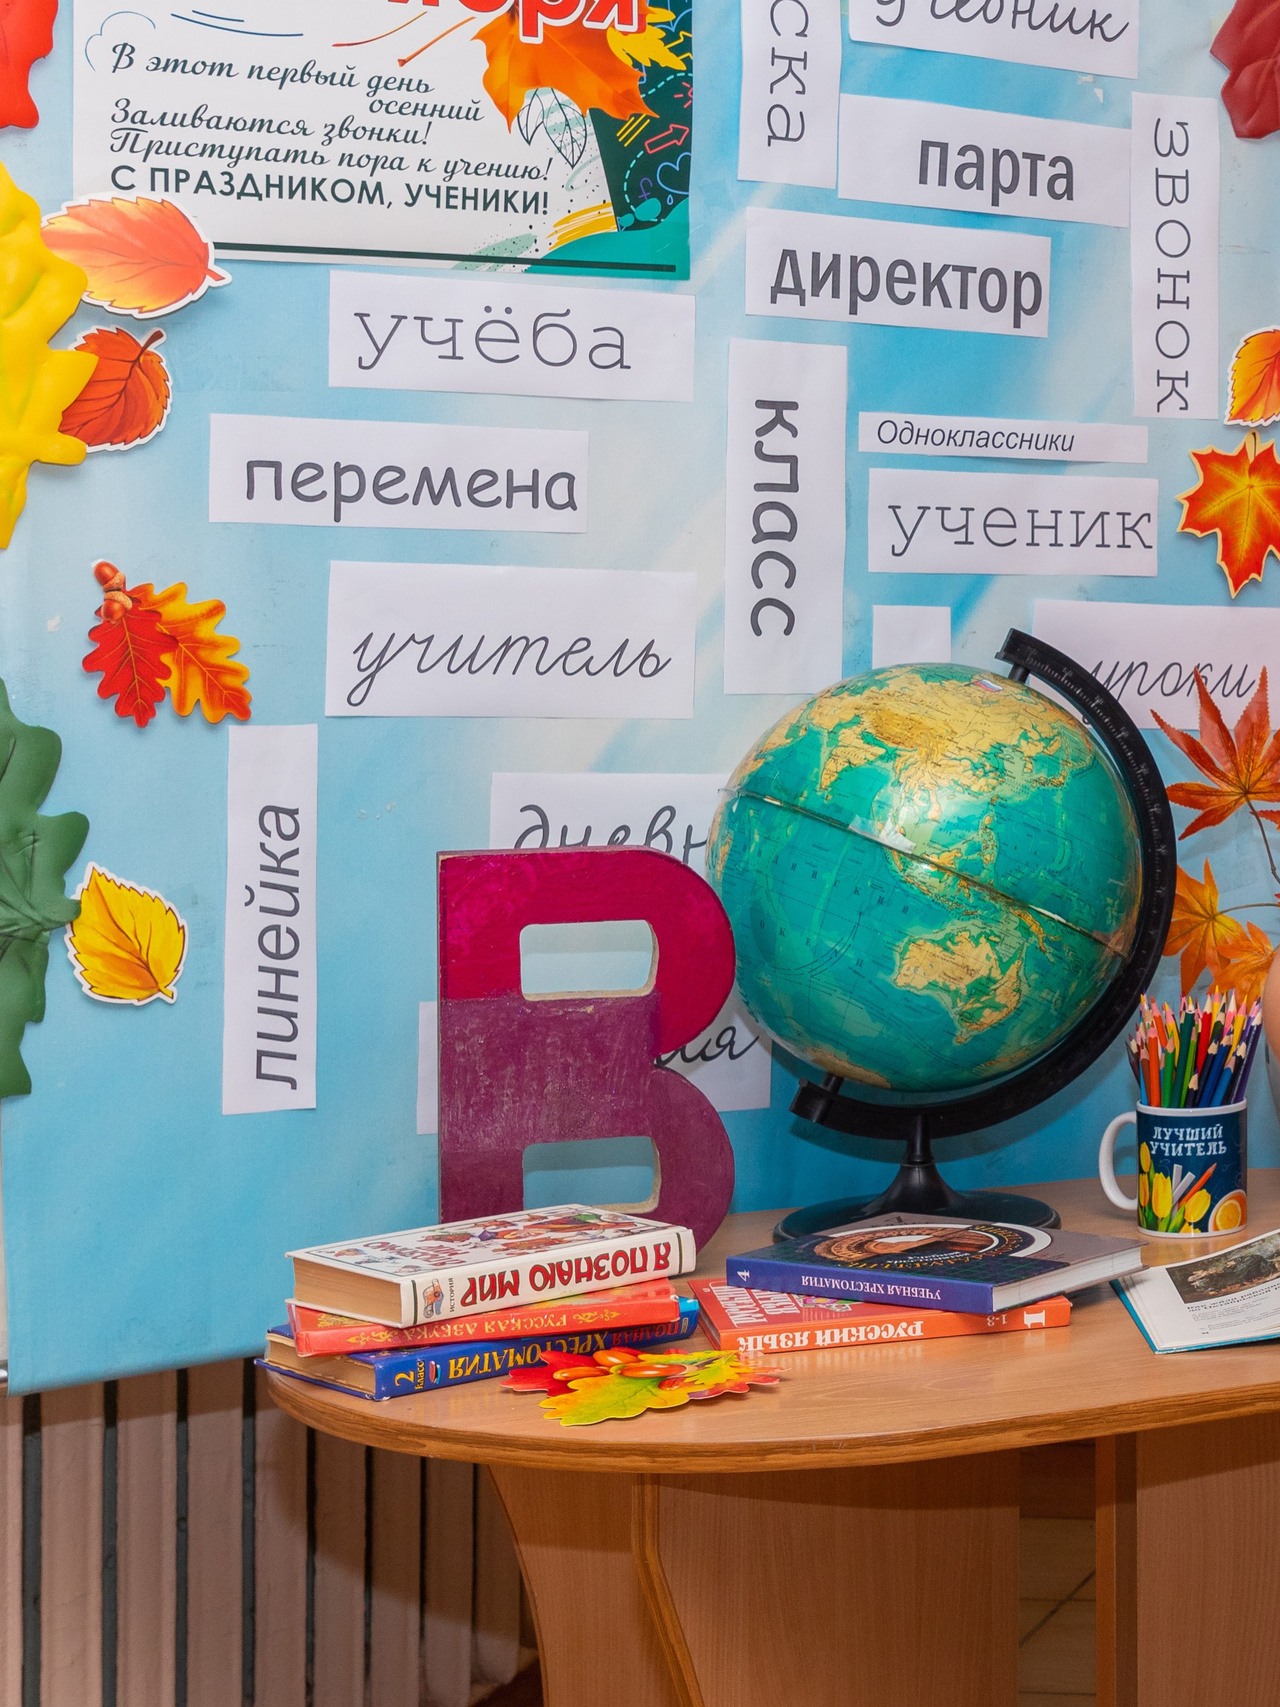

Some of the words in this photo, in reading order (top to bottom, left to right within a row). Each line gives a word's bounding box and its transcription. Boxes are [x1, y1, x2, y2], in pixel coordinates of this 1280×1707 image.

[111, 42, 136, 73] В
[145, 55, 239, 78] этот
[247, 59, 360, 90] первый
[366, 73, 435, 97] день
[110, 97, 315, 137] Заливаются
[321, 114, 432, 147] звонки!
[368, 98, 484, 121] осенний
[110, 127, 331, 168] Приступать
[337, 152, 410, 177] пора
[416, 157, 436, 173] к
[442, 157, 553, 182] учению!
[110, 164, 137, 191] С
[150, 167, 393, 209] ПРАЗДНИКОМ,
[404, 182, 549, 215] УЧЕНИКИ!
[918, 140, 1075, 206] парта
[1153, 118, 1191, 414] звонок
[770, 248, 1043, 328] директор
[354, 305, 632, 370] учёба
[876, 419, 1076, 453] Одноклассники
[245, 459, 578, 522] перемена
[749, 399, 801, 637] класс
[887, 504, 1154, 557] ученик
[346, 631, 673, 707] учитель
[244, 804, 300, 1090] линейка
[1149, 1141, 1227, 1157] УЧИТЕЛЬ
[1152, 1123, 1223, 1141] ЛУЧШИЙ
[529, 1246, 648, 1291] ПОЗНАЮ
[653, 1241, 672, 1271] Я
[460, 1269, 520, 1306] МИР
[737, 1270, 750, 1281] 4
[801, 1274, 885, 1296] ХРЕСТОМАТИЯ
[887, 1284, 942, 1300] УЧЕБНАЯ
[404, 1322, 478, 1341] АЗБУКА
[484, 1314, 567, 1333] РУССКАЯ
[612, 1321, 679, 1345] ПОЛНАЯ
[815, 1320, 924, 1347] РУССКИЙ
[987, 1313, 1008, 1327] 1-3
[737, 1331, 810, 1352] ЯЗЫК
[394, 1369, 415, 1387] 2
